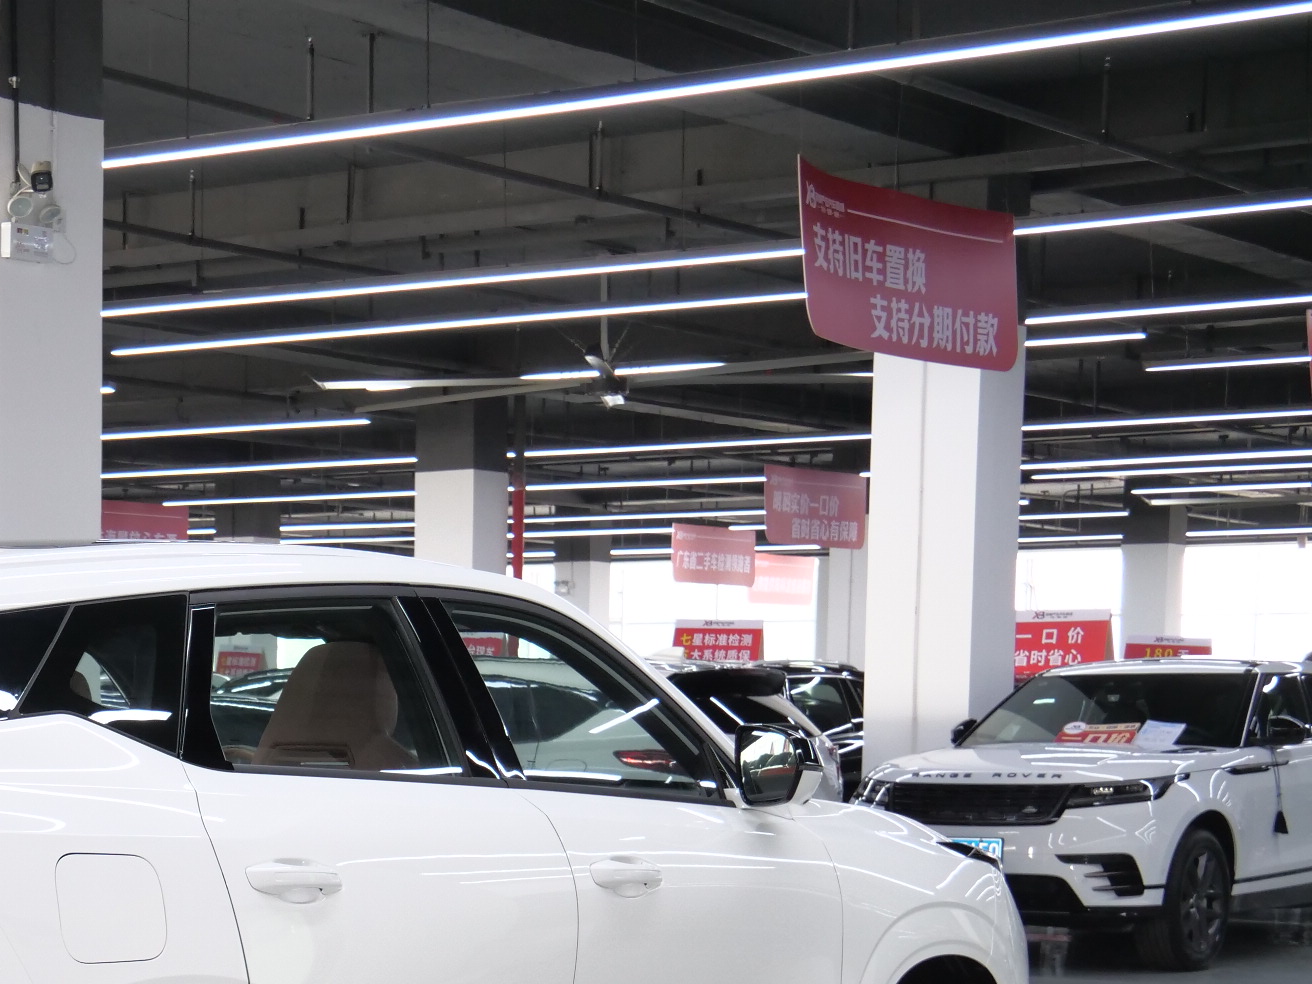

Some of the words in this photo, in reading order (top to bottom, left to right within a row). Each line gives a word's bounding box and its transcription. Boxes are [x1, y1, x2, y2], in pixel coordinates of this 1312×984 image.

[813, 222, 927, 295] 支持旧车置换
[870, 294, 999, 358] 支持分期付款
[681, 633, 753, 646] 七星标准检测
[1014, 649, 1082, 666] 省时省心
